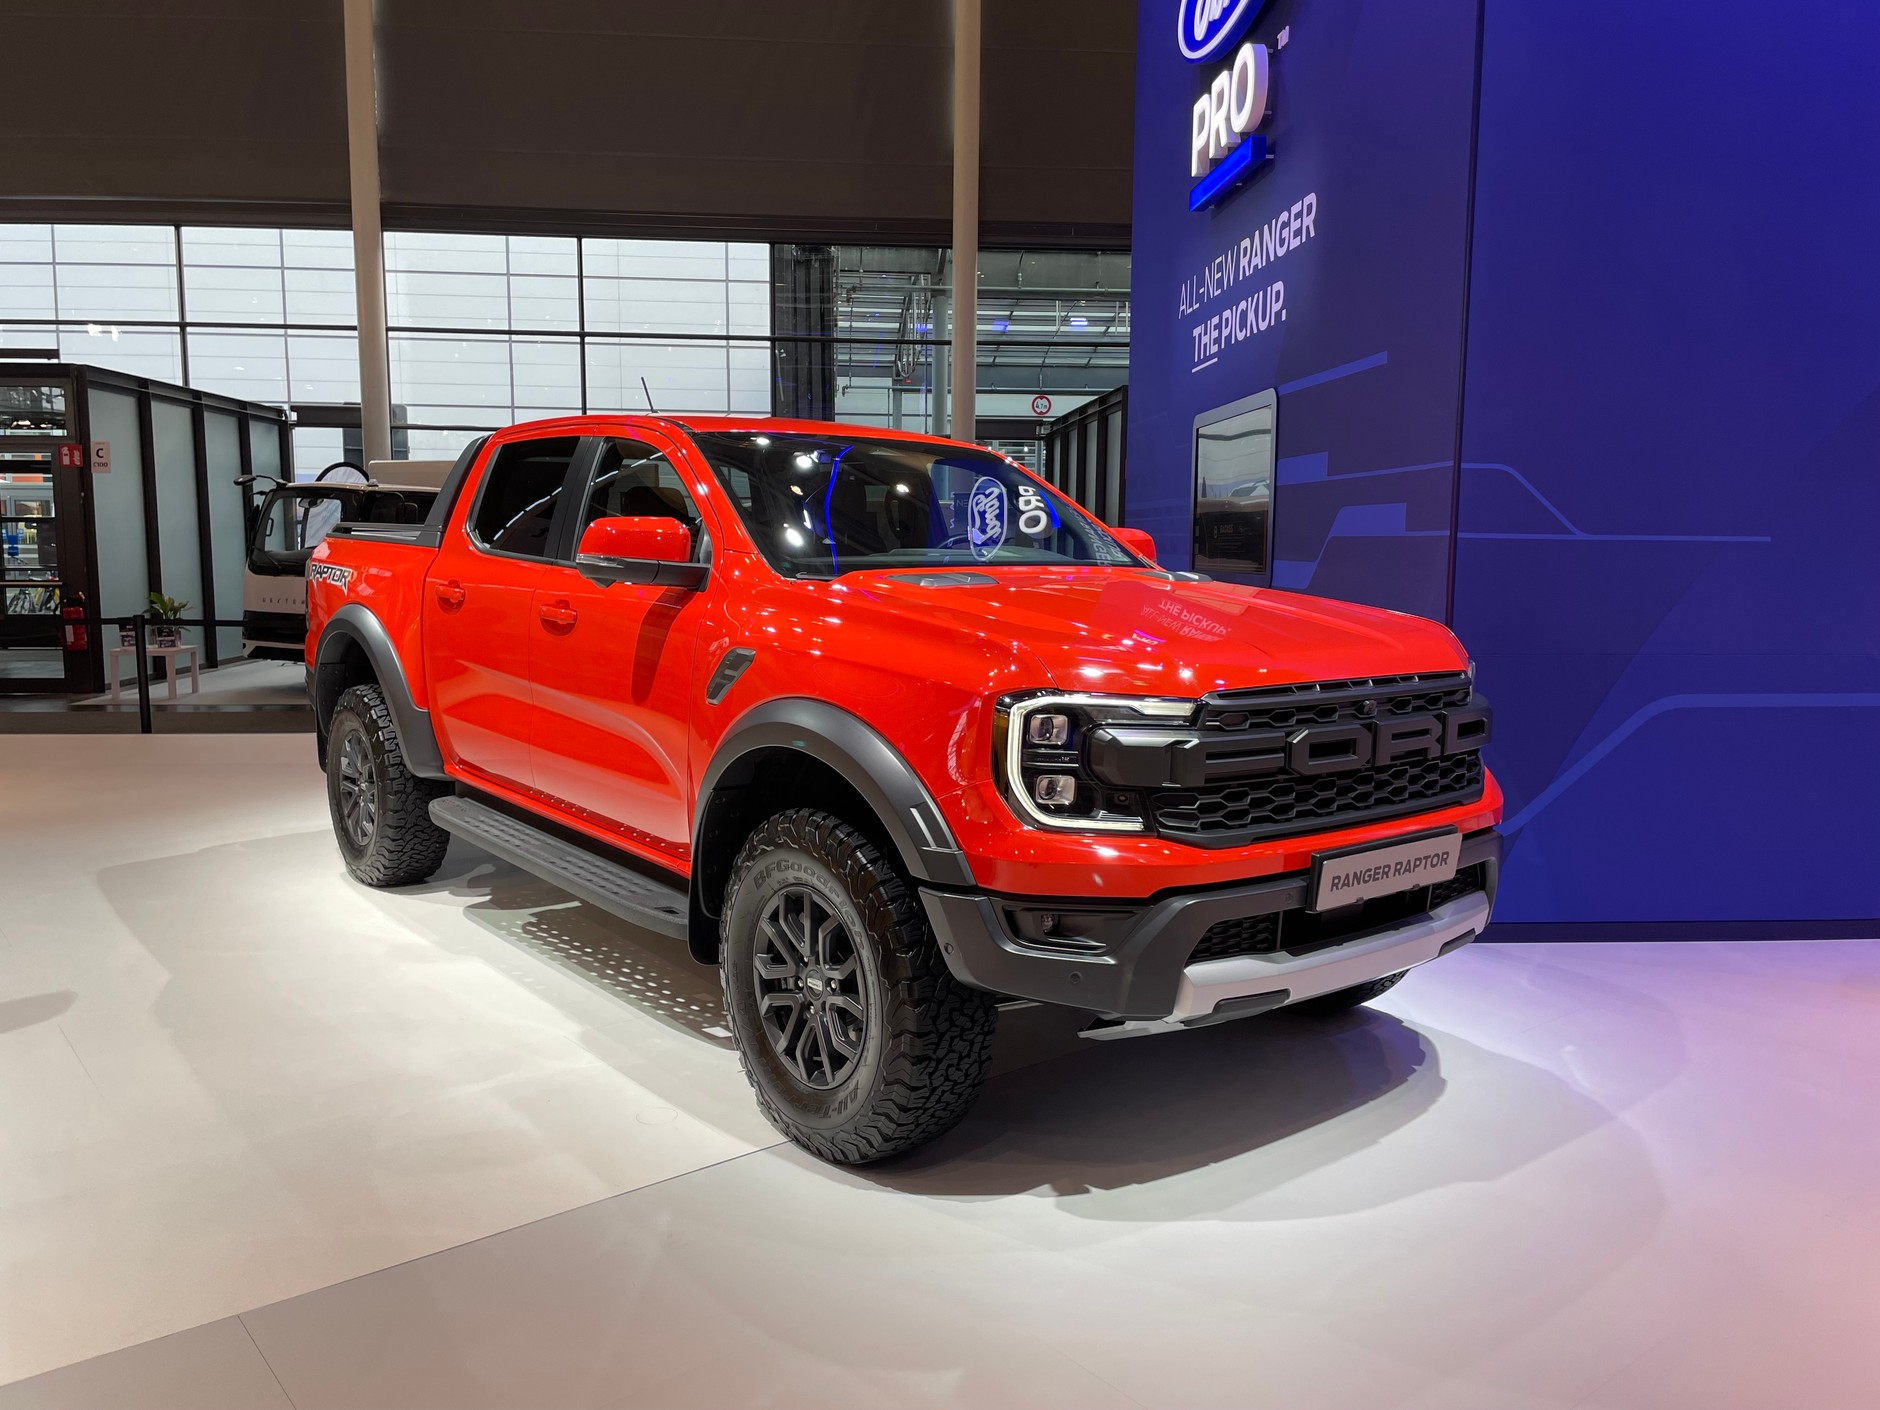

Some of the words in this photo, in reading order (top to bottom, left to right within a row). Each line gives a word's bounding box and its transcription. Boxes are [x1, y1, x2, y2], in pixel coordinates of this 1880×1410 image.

[1191, 43, 1268, 178] PRO
[1178, 245, 1239, 320] ALL-NEW
[1239, 192, 1318, 281] RANGER
[1192, 314, 1220, 364] THE
[1220, 280, 1288, 350] PICKUP.
[96, 447, 104, 459] C
[310, 562, 352, 596] RAPTOR
[1172, 710, 1490, 787] FORD
[753, 859, 865, 952] BFGoodrich
[1330, 864, 1391, 892] RANGER
[1393, 851, 1450, 877] RAPTOR
